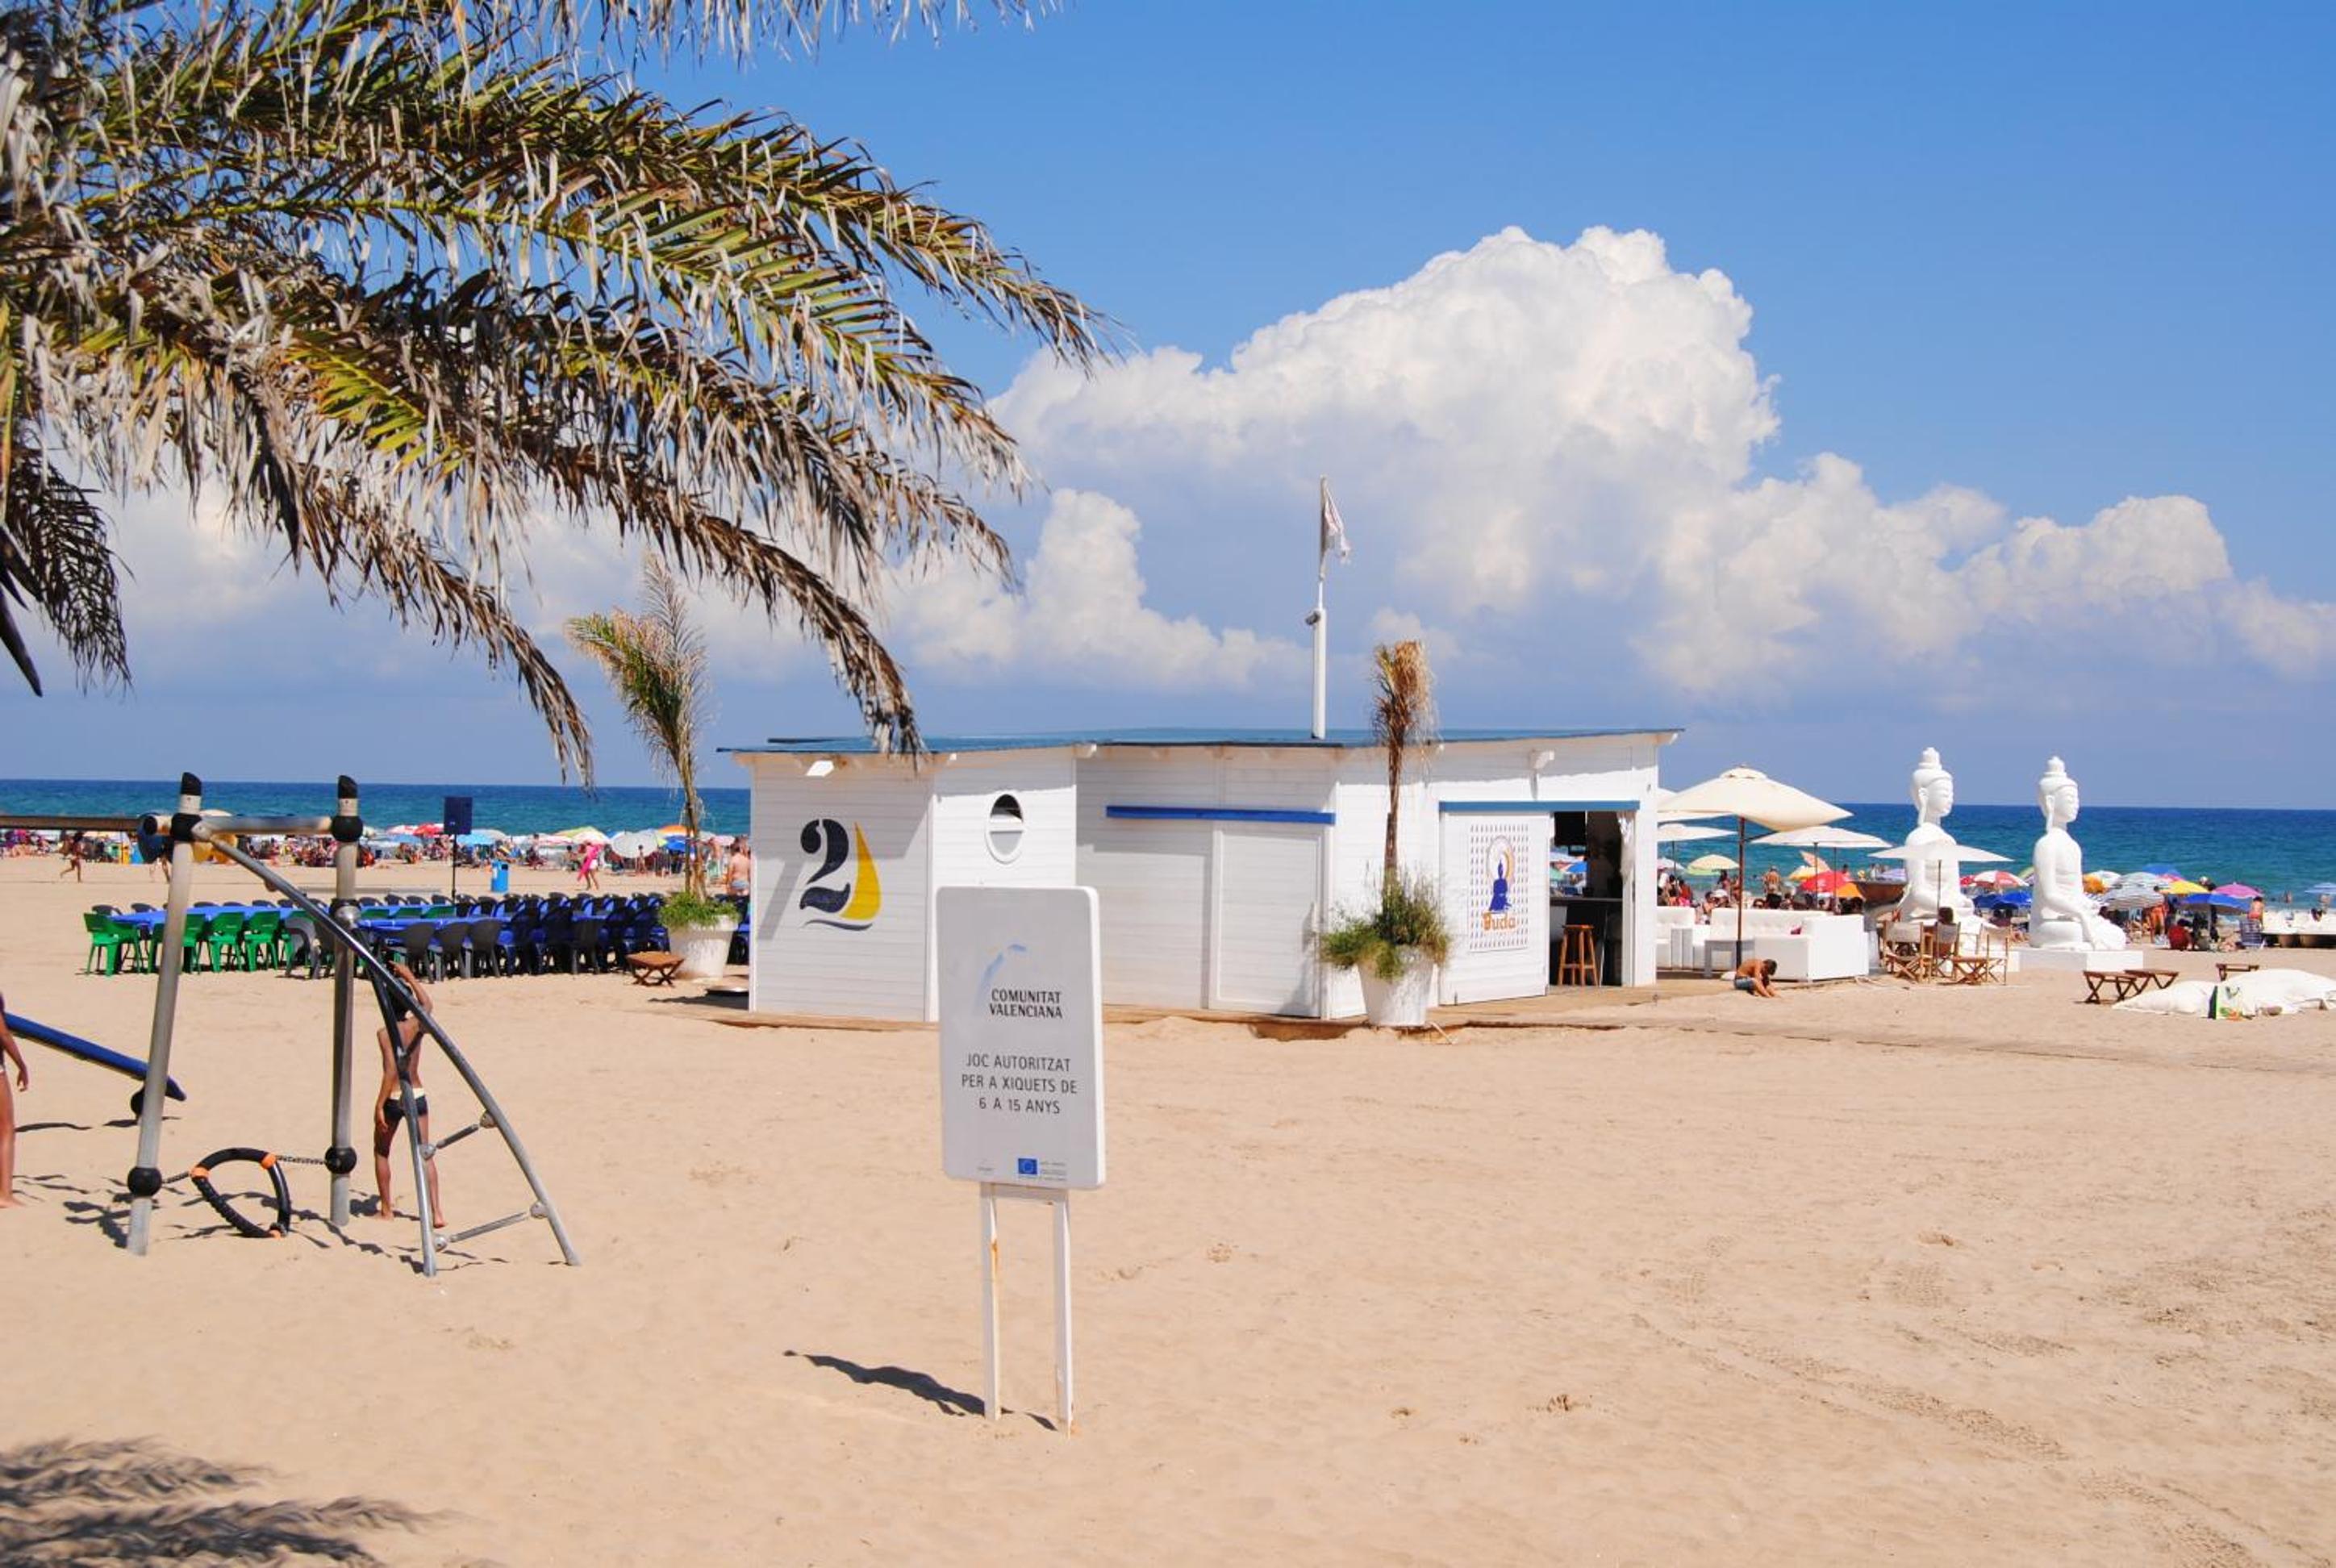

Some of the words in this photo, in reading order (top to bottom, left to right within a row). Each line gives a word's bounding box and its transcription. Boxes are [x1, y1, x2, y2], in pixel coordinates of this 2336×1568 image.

[799, 819, 851, 913] 2
[1483, 912, 1516, 931] Buda
[991, 988, 1062, 1003] COMUNITAT
[990, 1003, 1063, 1019] VALENCIANA
[966, 1053, 989, 1067] JOC
[994, 1054, 1071, 1072] AUTORITZAT
[962, 1074, 983, 1088] PER
[989, 1075, 998, 1090] A
[1002, 1076, 1056, 1093] XIQUETS
[1061, 1079, 1078, 1094] DE
[978, 1097, 987, 1110] 6
[993, 1097, 1002, 1111] A
[1008, 1098, 1021, 1112] 15
[1025, 1099, 1061, 1115] ANYS
